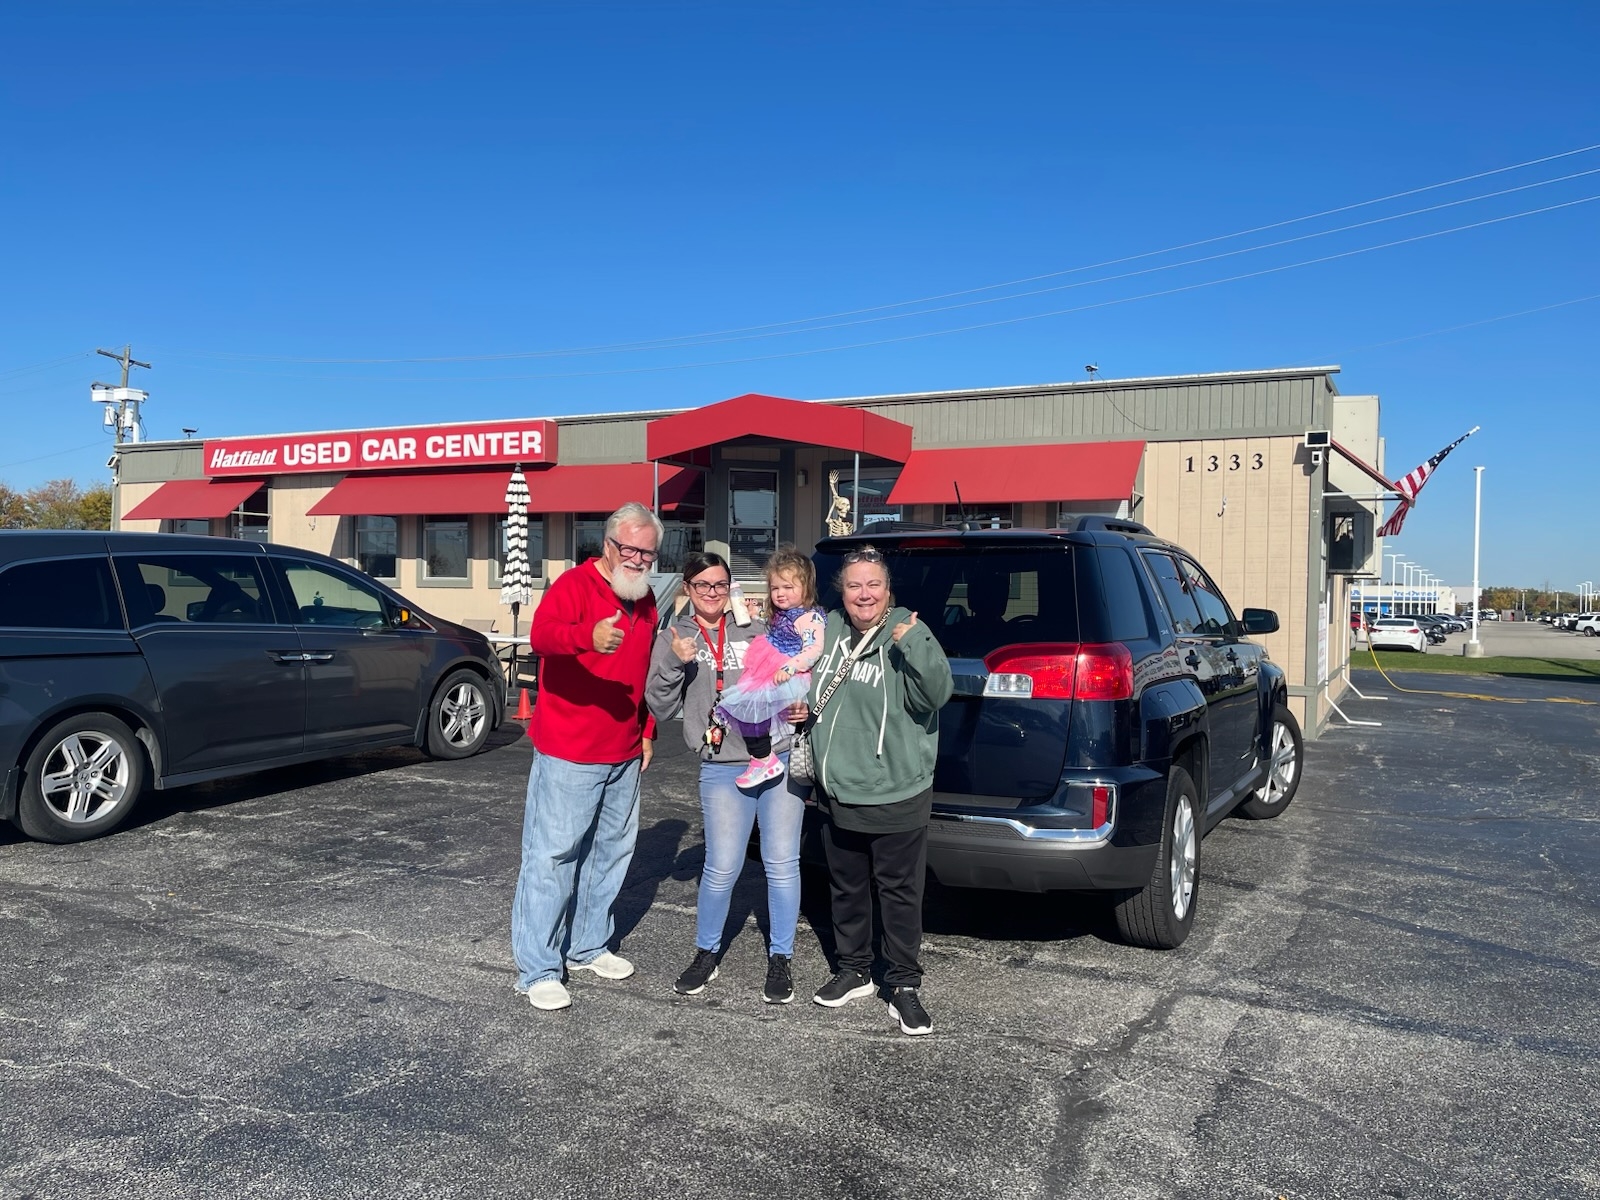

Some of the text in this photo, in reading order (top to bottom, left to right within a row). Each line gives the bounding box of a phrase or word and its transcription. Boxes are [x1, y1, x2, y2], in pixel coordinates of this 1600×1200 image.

[210, 430, 542, 468] Hatfield USED CAR CENTER
[1185, 453, 1264, 472] 1333
[814, 657, 856, 715] MICHAEL KORS
[850, 661, 883, 688] NAVY
